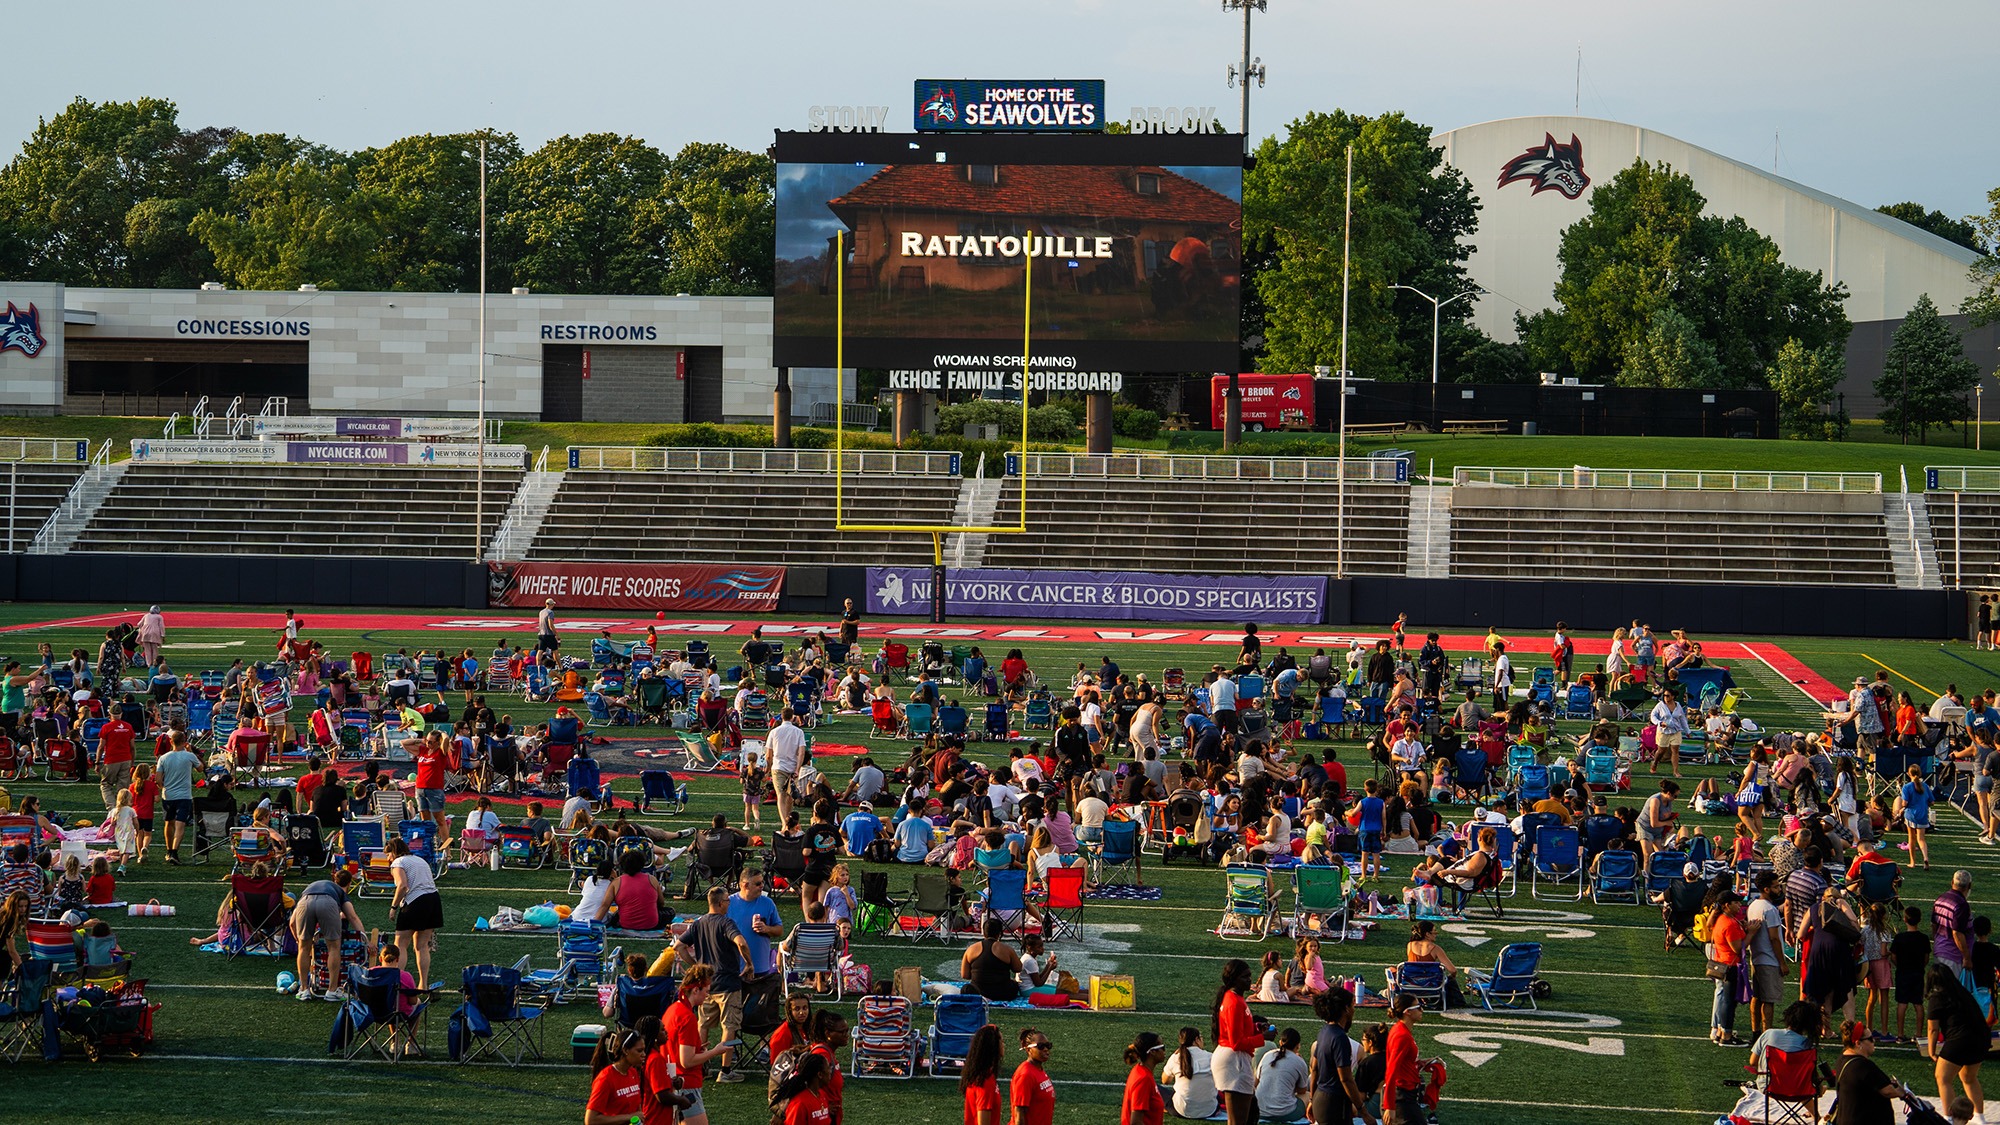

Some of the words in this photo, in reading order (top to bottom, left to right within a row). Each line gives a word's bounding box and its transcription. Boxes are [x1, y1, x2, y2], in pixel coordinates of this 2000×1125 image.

[985, 88, 1025, 102] HOME
[1026, 88, 1046, 102] OF
[1047, 88, 1075, 102] THE
[808, 105, 889, 133] STONY
[1130, 106, 1216, 134] BROOK
[964, 103, 1096, 126] SEAWOLVES
[901, 231, 1114, 258] RATATOUILLE
[177, 319, 311, 336] CONCESSIONS
[541, 325, 657, 340] RESTROOMS
[933, 355, 989, 368] (WOMAN
[992, 355, 1077, 369] SCREAMING)
[889, 370, 941, 389] KEHOE
[948, 370, 1005, 390] FAMILY
[1011, 371, 1123, 392] SCOREBOARD
[1248, 387, 1274, 396] BROOK
[308, 446, 388, 459] NYCANCER.COM
[519, 575, 568, 595] WHERE
[571, 576, 622, 596] WOLFIE
[624, 577, 681, 599] SCORES
[960, 583, 1013, 601] YORK
[1017, 584, 1097, 603] CANCER
[1101, 586, 1116, 604] &
[1121, 587, 1190, 607] BLOOD
[1195, 589, 1317, 609] SPECIALISTS
